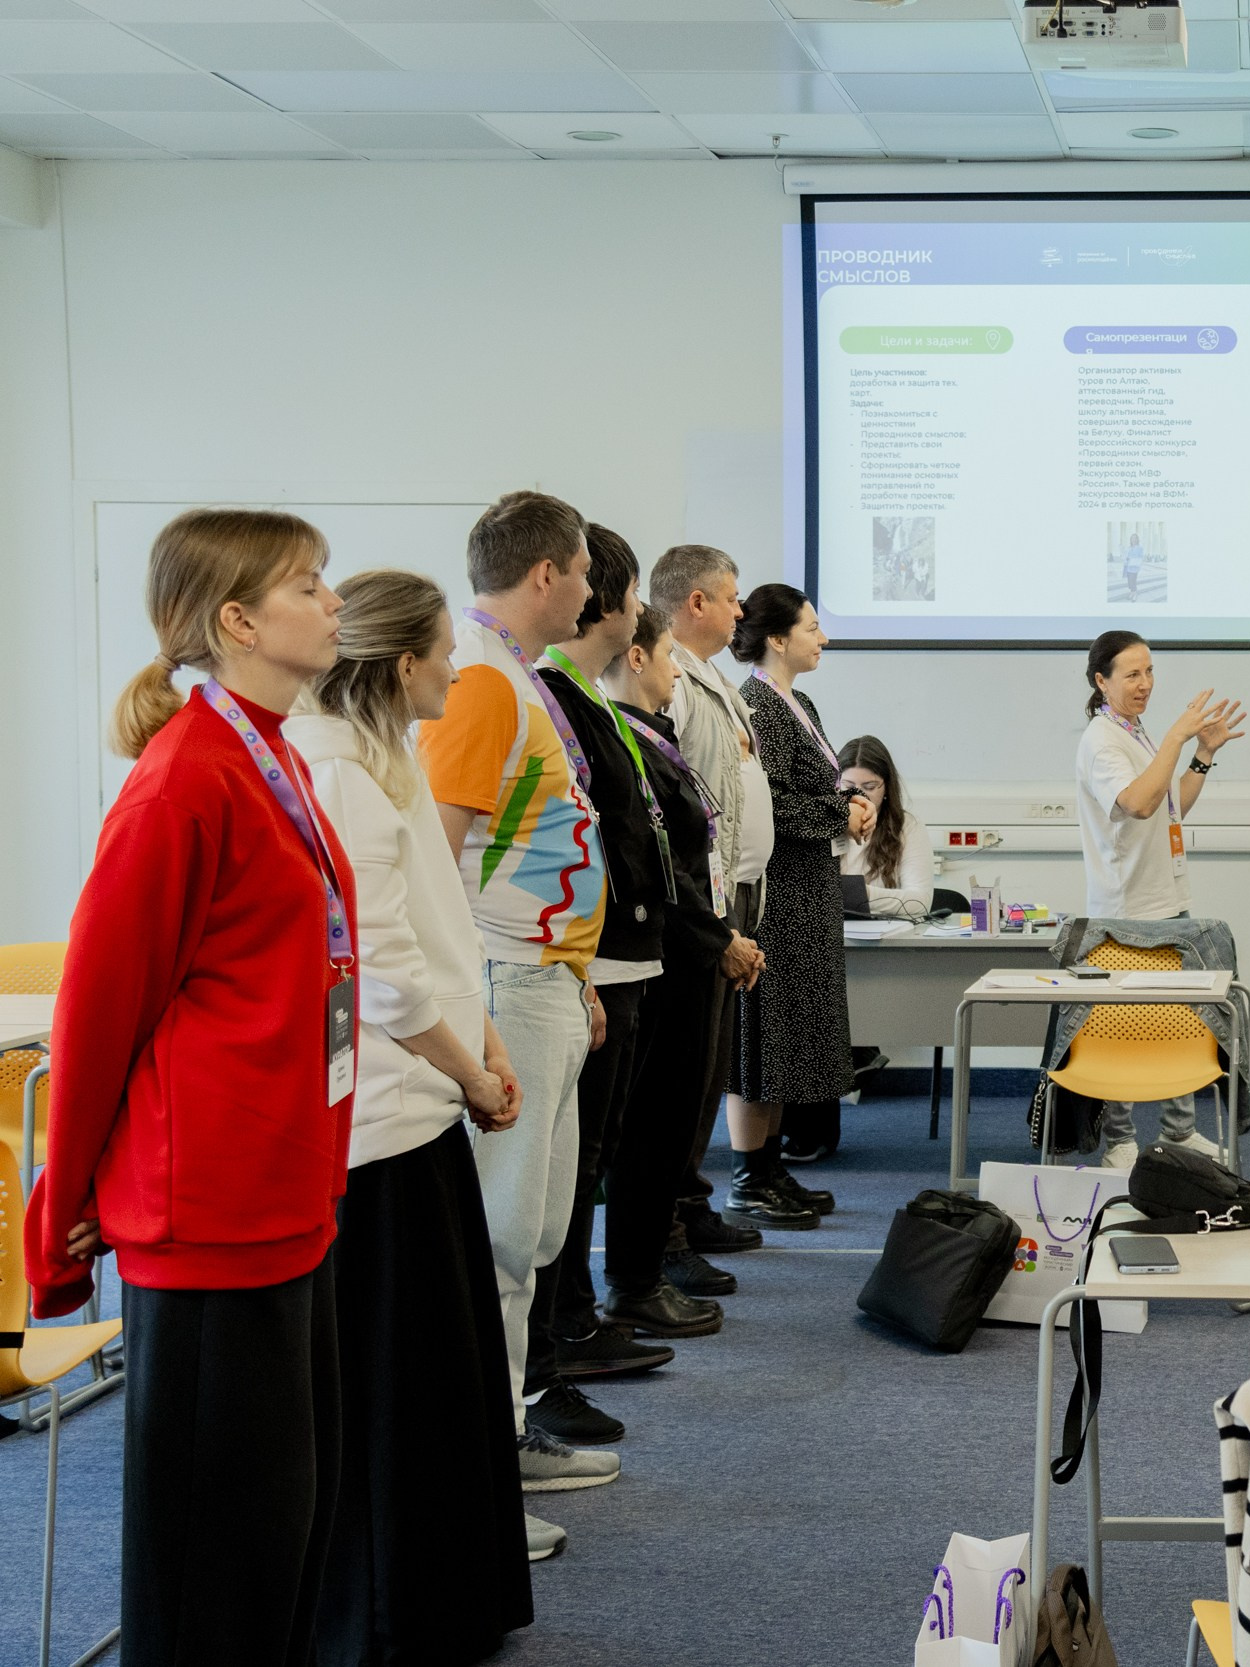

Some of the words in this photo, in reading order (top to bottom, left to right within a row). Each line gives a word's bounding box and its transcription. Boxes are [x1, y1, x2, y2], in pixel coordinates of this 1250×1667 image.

[818, 250, 932, 266] ПРОВОДНИК
[818, 270, 911, 283] СМЫСЛОВ
[880, 336, 912, 348] Цели
[915, 337, 923, 346] и
[926, 337, 973, 348] задачи:
[1086, 332, 1188, 344] Самопрезентаци
[850, 369, 873, 377] Цель
[1078, 367, 1137, 375] Организатор
[849, 379, 898, 388] доработка
[1077, 378, 1104, 386] туров
[1137, 398, 1174, 406] Прошла
[861, 431, 923, 439] Проводников
[861, 441, 919, 449] Представить
[1078, 439, 1153, 447] Всероссийского
[1078, 449, 1140, 457] «Проводники
[860, 461, 929, 470] Сформировать
[1078, 460, 1113, 468] первый
[1078, 469, 1137, 478] Экскурсовод
[1139, 469, 1162, 477] МВФ
[861, 482, 922, 490] направлений
[1153, 480, 1195, 488] работала
[860, 492, 908, 500] доработке
[1078, 491, 1148, 499] экскурсоводом
[861, 502, 904, 510] Защитить
[1078, 500, 1100, 508] 2024
[1108, 500, 1143, 509] службе
